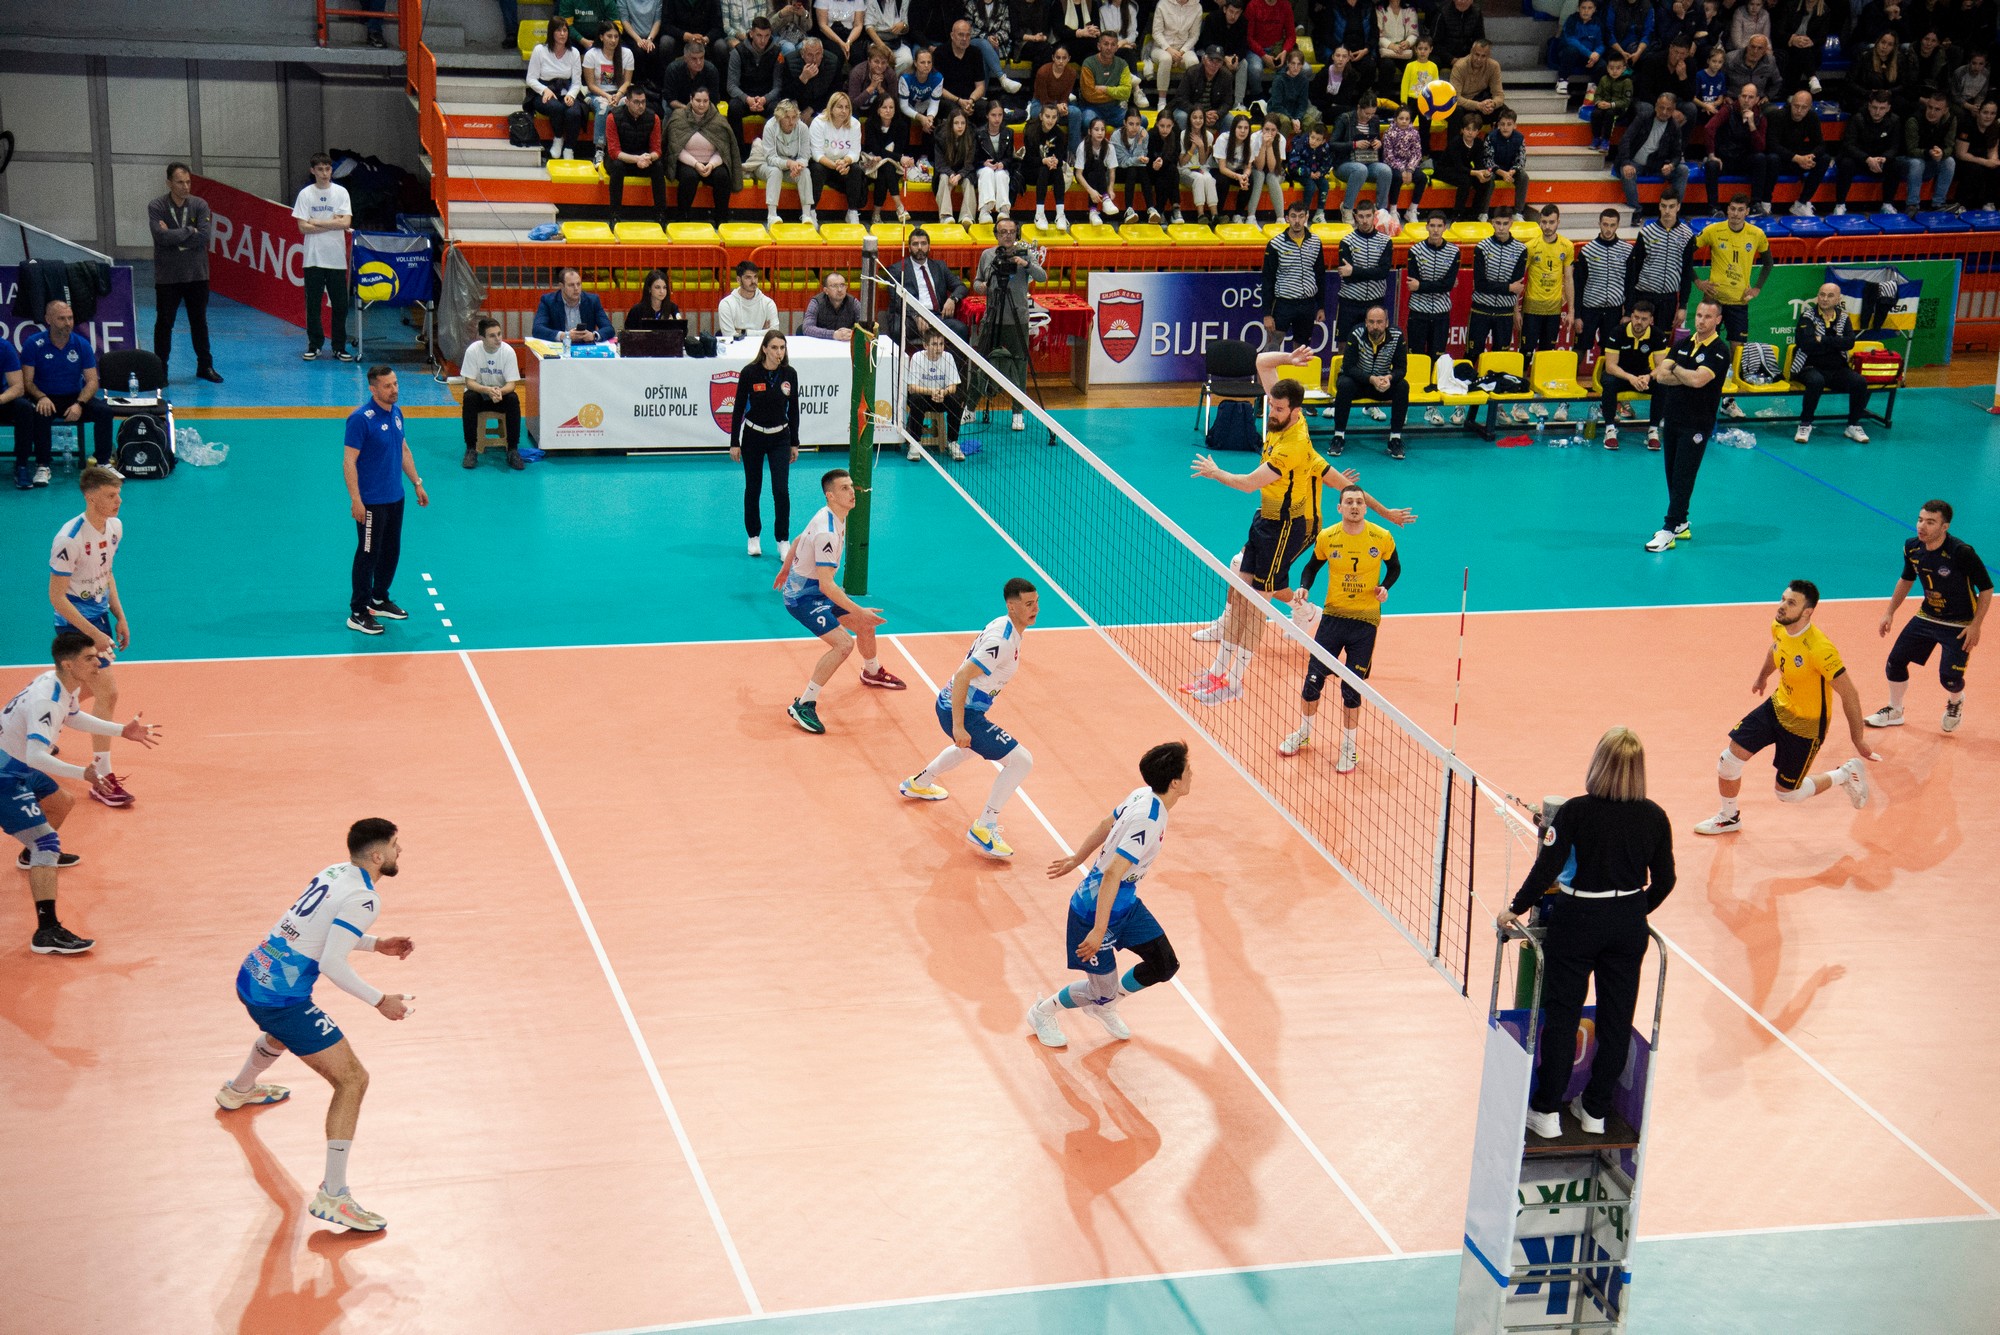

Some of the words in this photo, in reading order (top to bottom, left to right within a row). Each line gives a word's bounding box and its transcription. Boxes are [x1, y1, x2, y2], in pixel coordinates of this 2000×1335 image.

[824, 139, 851, 149] BOSS
[645, 384, 687, 399] OPŠTINA
[798, 385, 826, 397] ALITY
[827, 385, 839, 397] OF
[634, 404, 666, 417] BIJELO
[668, 403, 698, 417] POLJE
[800, 402, 829, 414] POLJE
[100, 552, 107, 566] 3
[1351, 557, 1359, 573] 7
[1926, 574, 1934, 590] 1
[816, 615, 826, 627] 9
[1779, 656, 1786, 673] 8
[995, 730, 1012, 745] 15
[20, 802, 41, 818] 16
[290, 876, 329, 917] 20
[1089, 954, 1099, 967] 8
[315, 1014, 337, 1036] 20
